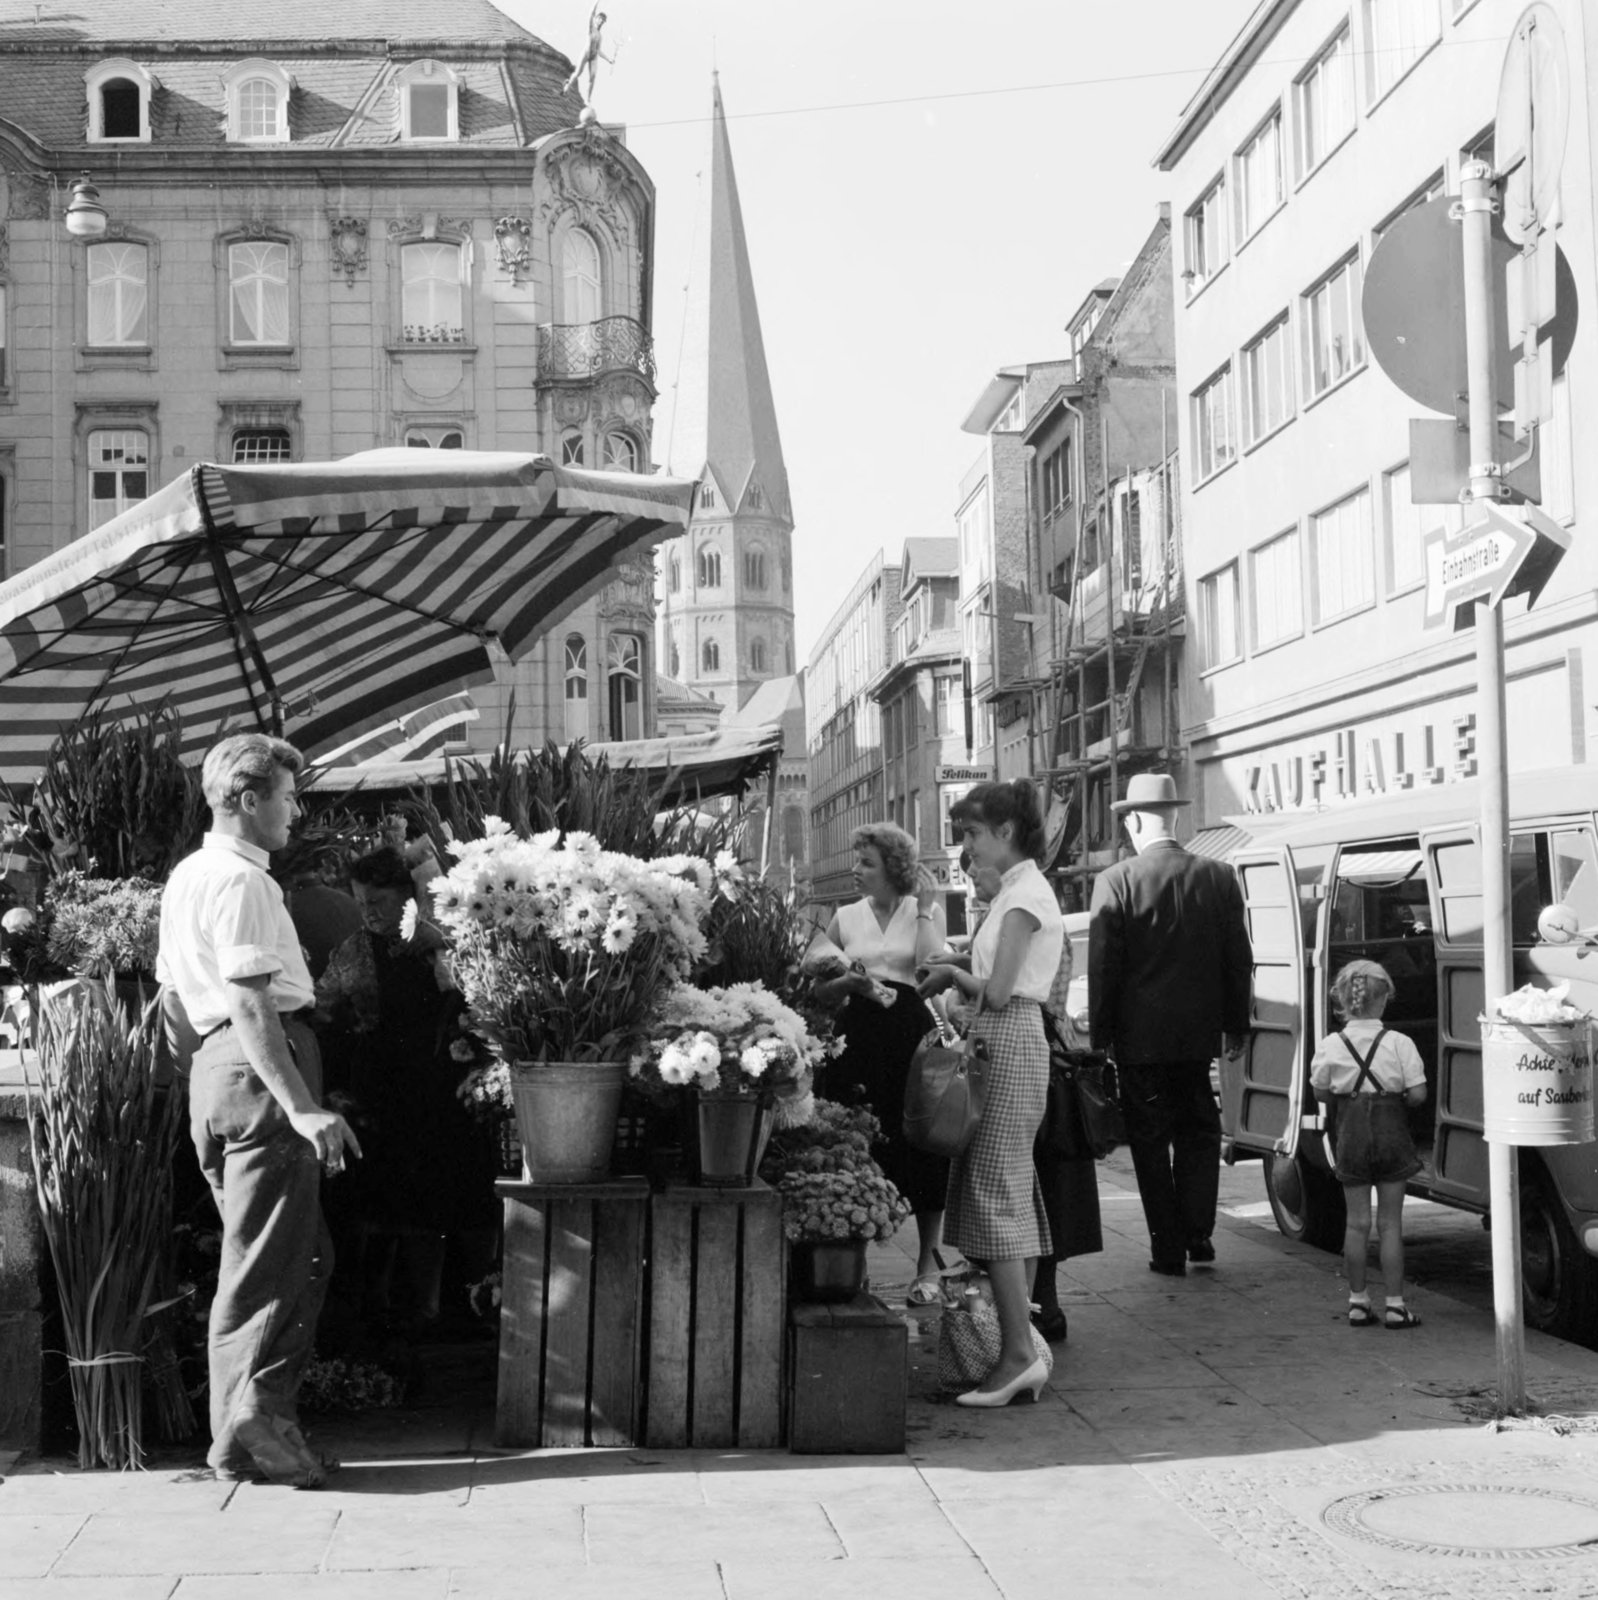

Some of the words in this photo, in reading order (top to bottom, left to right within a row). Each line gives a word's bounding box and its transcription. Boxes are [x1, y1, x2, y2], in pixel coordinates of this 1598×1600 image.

[1443, 539, 1499, 584] Einbahnstraße
[1243, 714, 1477, 814] KAUFHALLE
[942, 769, 987, 779] Pelikan
[1516, 1053, 1555, 1071] Achte
[1518, 1088, 1542, 1107] auf
